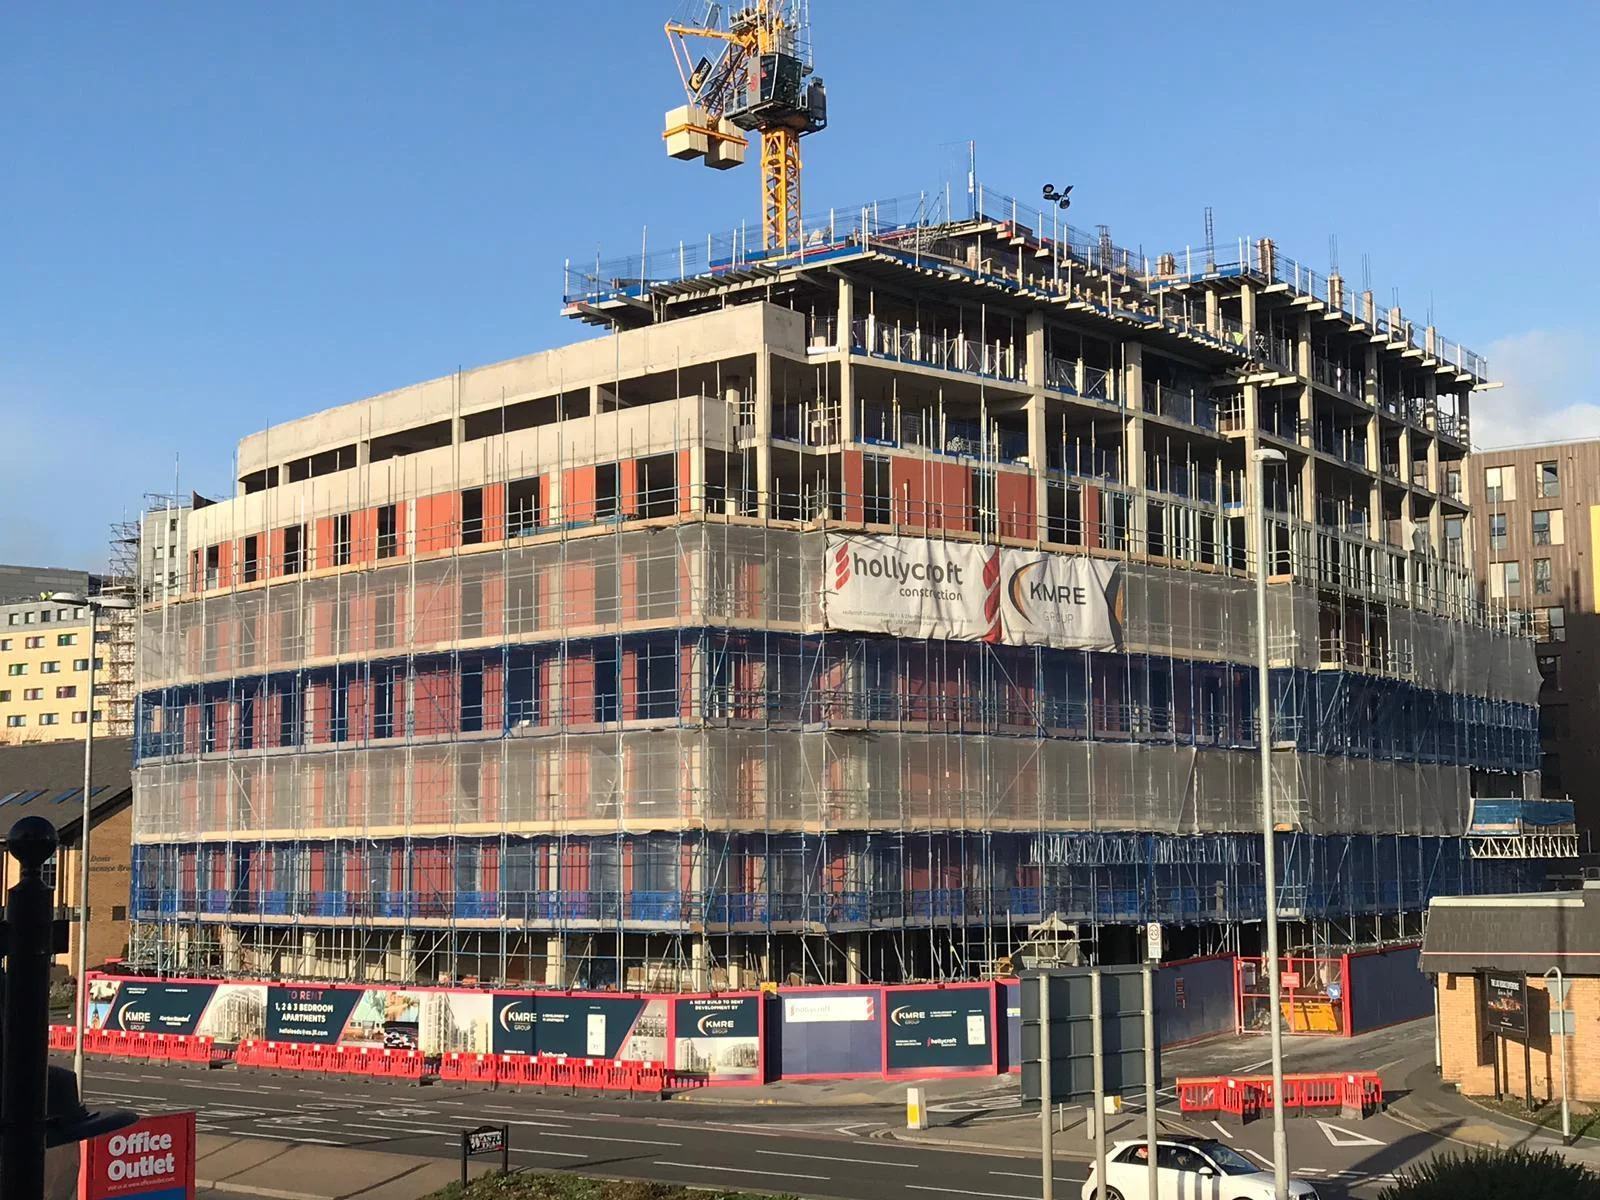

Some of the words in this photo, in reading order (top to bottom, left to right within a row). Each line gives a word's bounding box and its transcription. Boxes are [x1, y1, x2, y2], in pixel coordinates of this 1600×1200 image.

[853, 552, 963, 585] hollycroft
[1030, 581, 1087, 605] KMRE
[300, 990, 324, 1001] RENT
[281, 1002, 287, 1011] 2
[299, 1003, 334, 1013] BEDROOM
[125, 1011, 151, 1022] KMRE
[281, 1013, 326, 1023] APARTMENTS
[508, 1011, 538, 1022] KMRE
[899, 1011, 926, 1019] KMRE
[705, 1020, 735, 1028] KMRE
[108, 1131, 172, 1157] Office
[107, 1153, 175, 1181] Outlet
